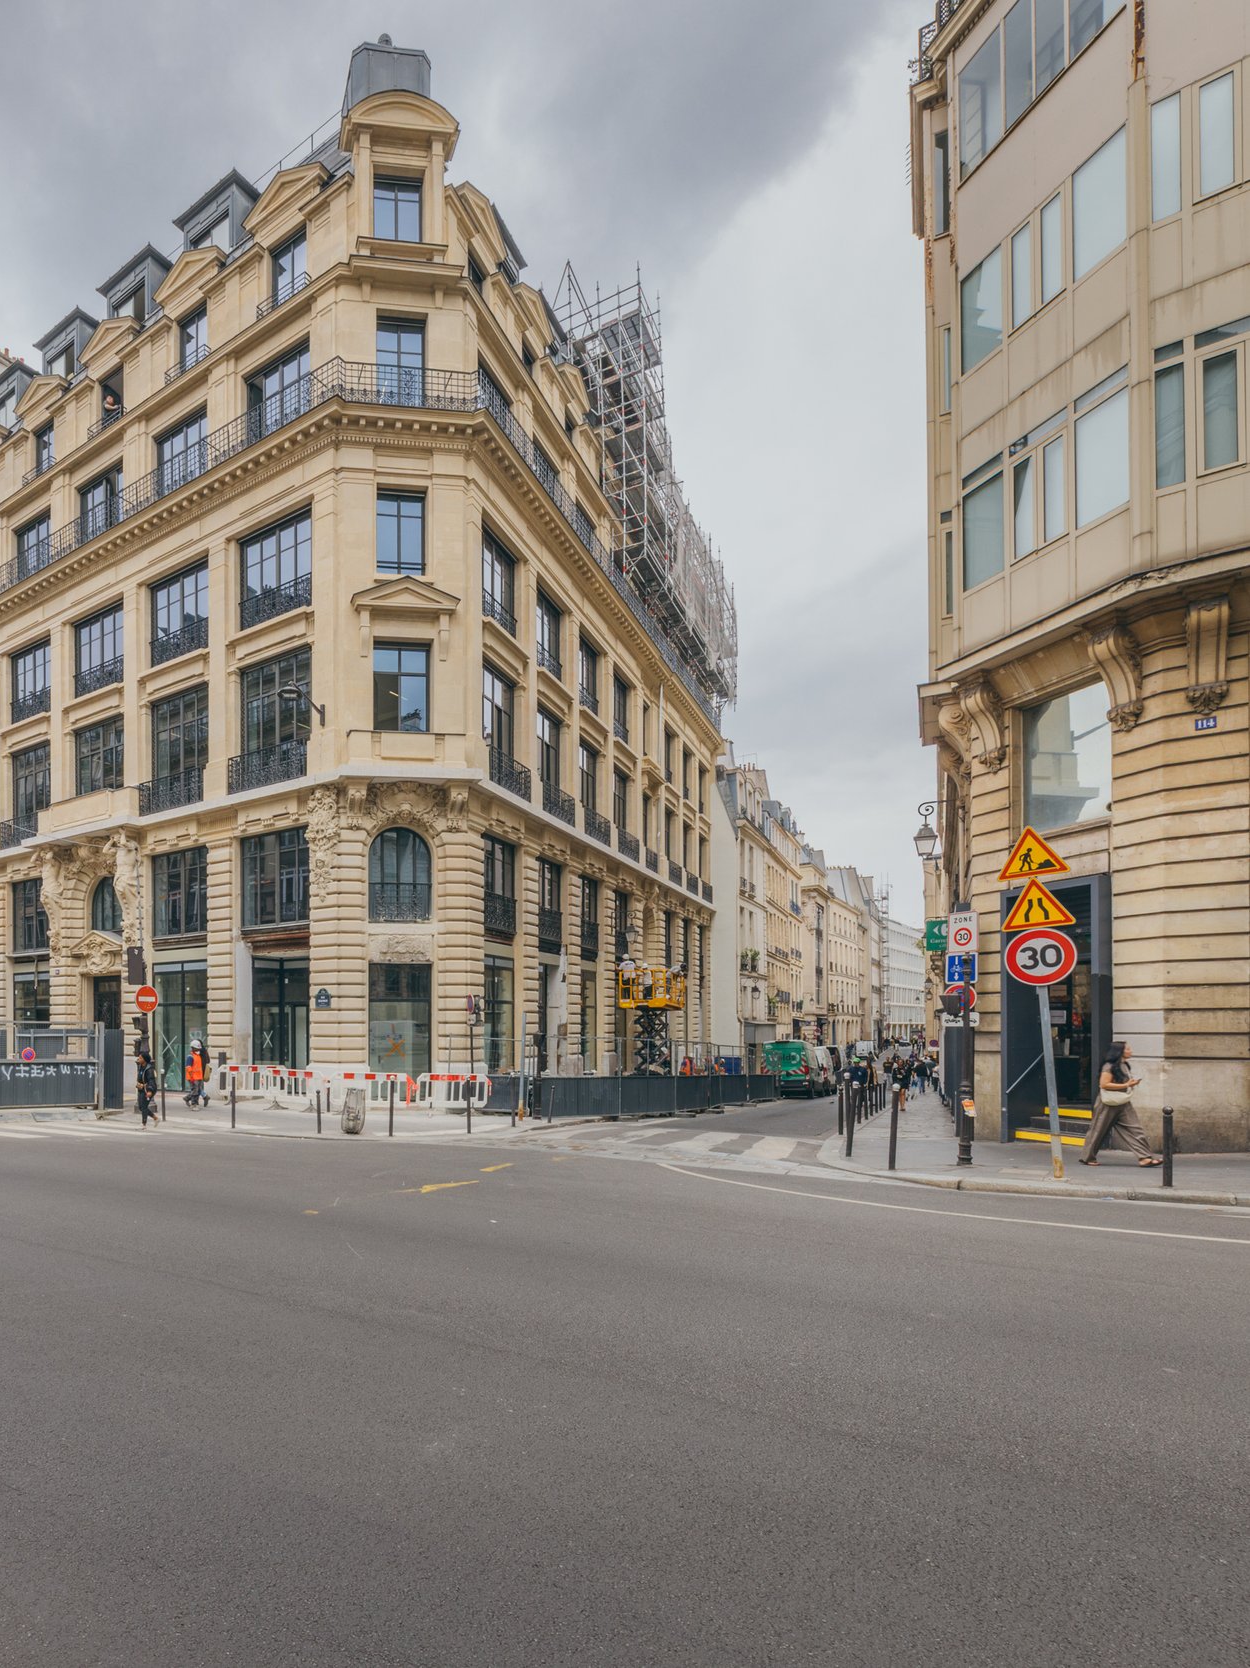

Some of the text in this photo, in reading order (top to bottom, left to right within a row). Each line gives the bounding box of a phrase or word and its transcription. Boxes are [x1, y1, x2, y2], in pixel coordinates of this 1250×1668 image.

[954, 915, 973, 924] ZONE
[957, 932, 969, 941] 30
[1019, 943, 1063, 970] 30
